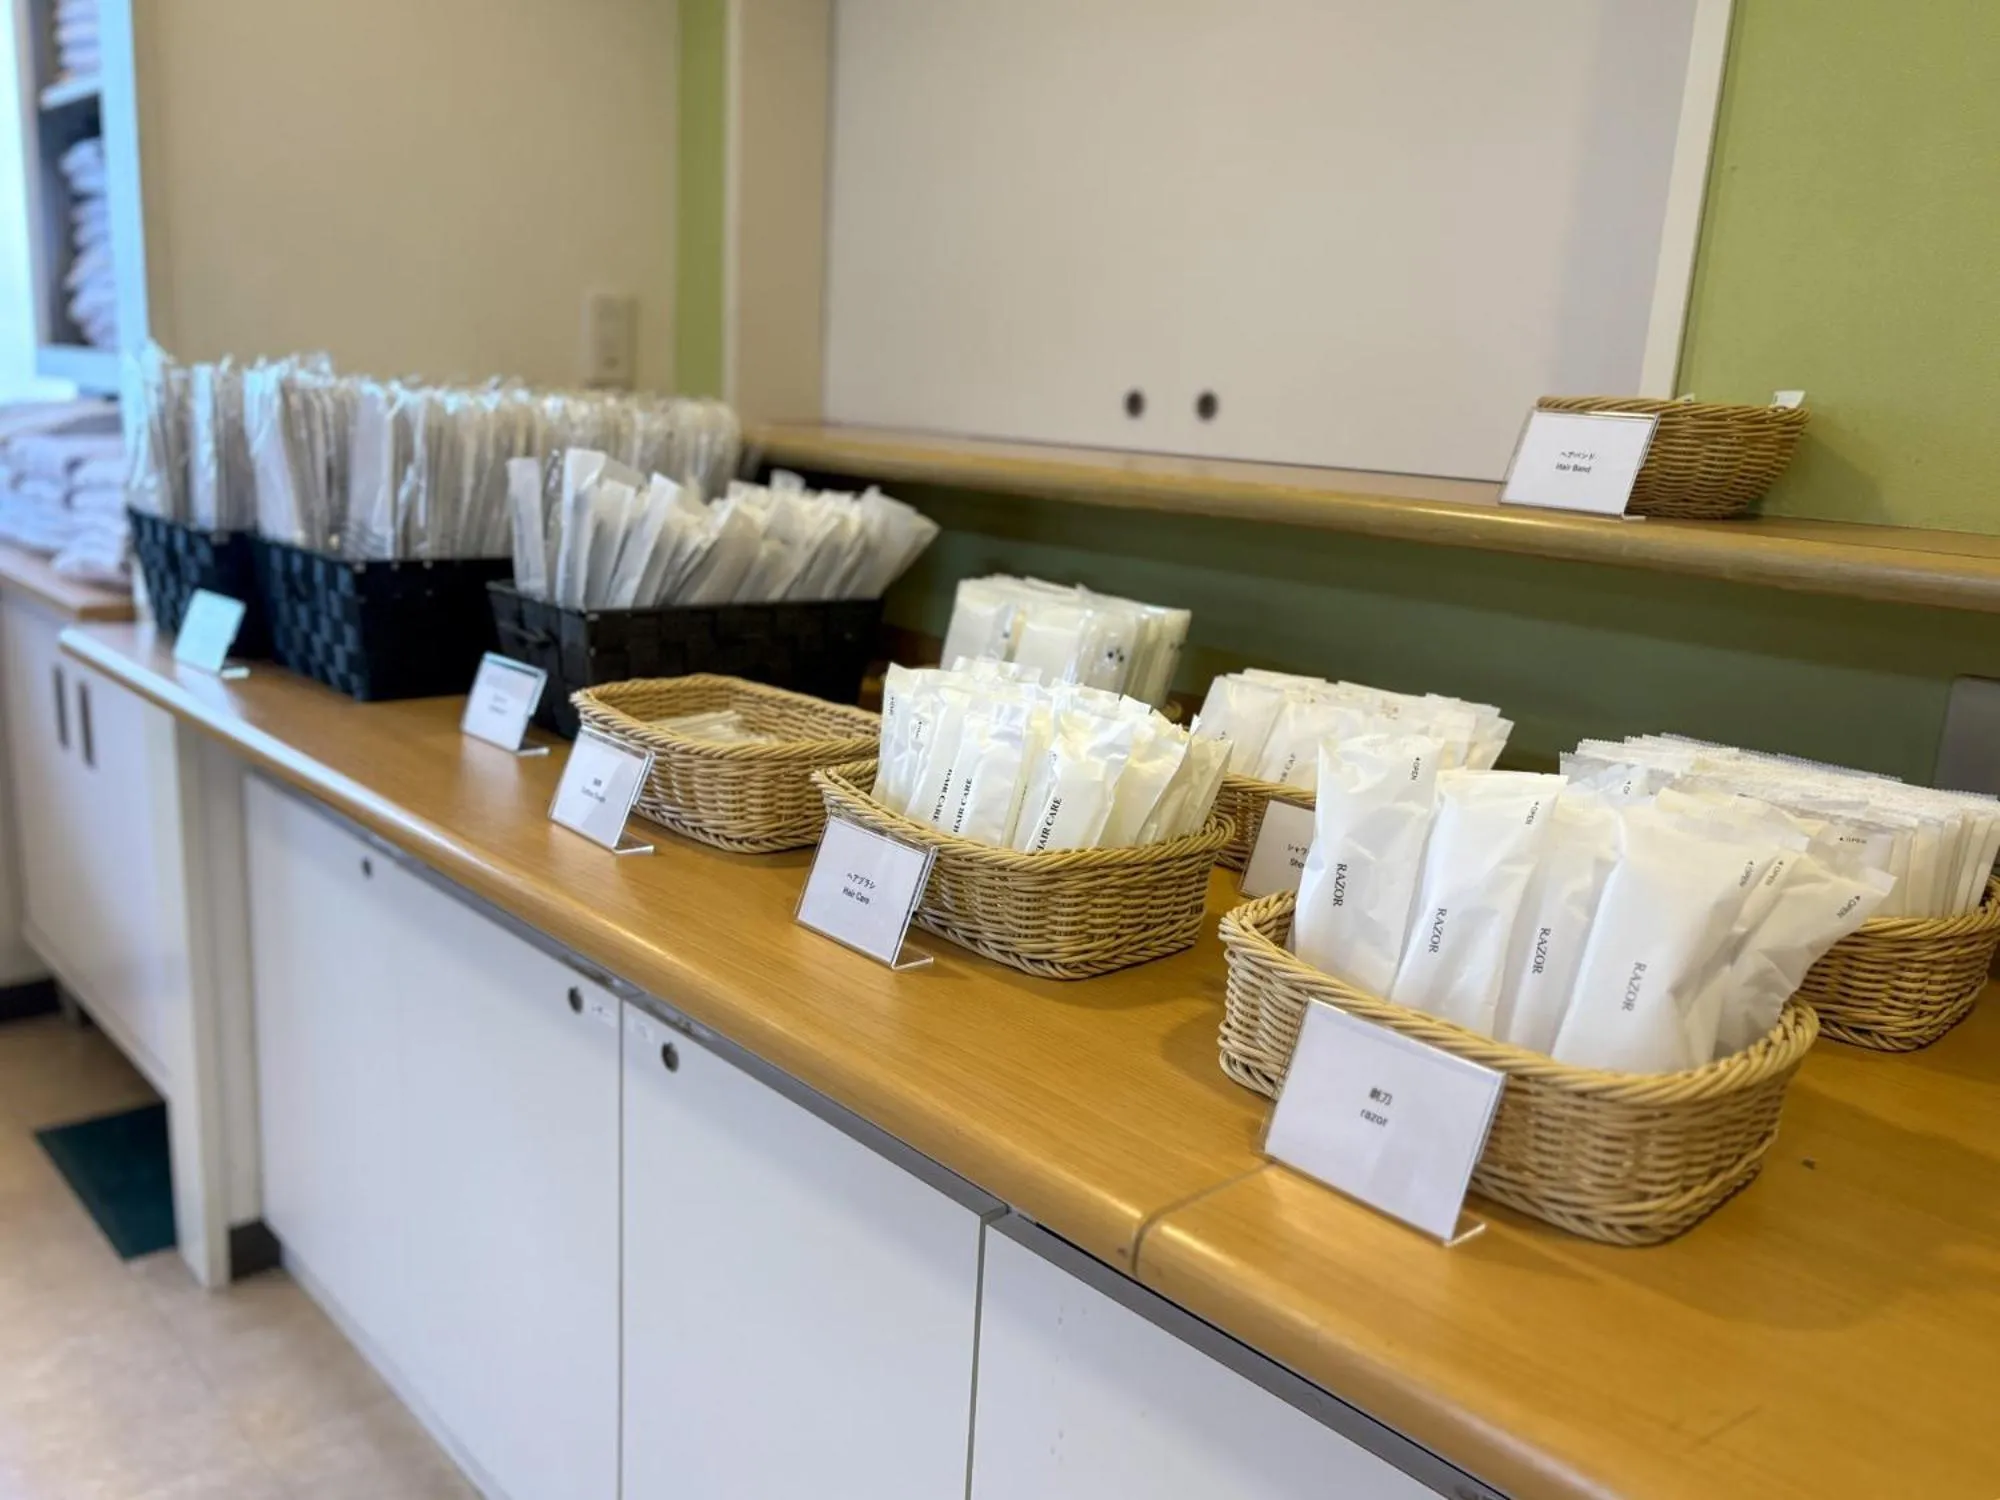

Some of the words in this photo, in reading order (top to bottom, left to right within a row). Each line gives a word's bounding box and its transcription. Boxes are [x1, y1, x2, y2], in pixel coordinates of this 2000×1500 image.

[961, 778, 972, 806] CARE
[1045, 798, 1062, 827] CARE
[1287, 843, 1308, 856] シャワ
[1289, 858, 1305, 869] Sho
[1332, 863, 1348, 907] RAZOR
[1836, 899, 1857, 918] OPEN
[1428, 908, 1447, 953] RAZOR
[1531, 927, 1551, 974] RAZOR
[1621, 961, 1648, 1012] RAZOR
[1360, 1109, 1388, 1127] razor
